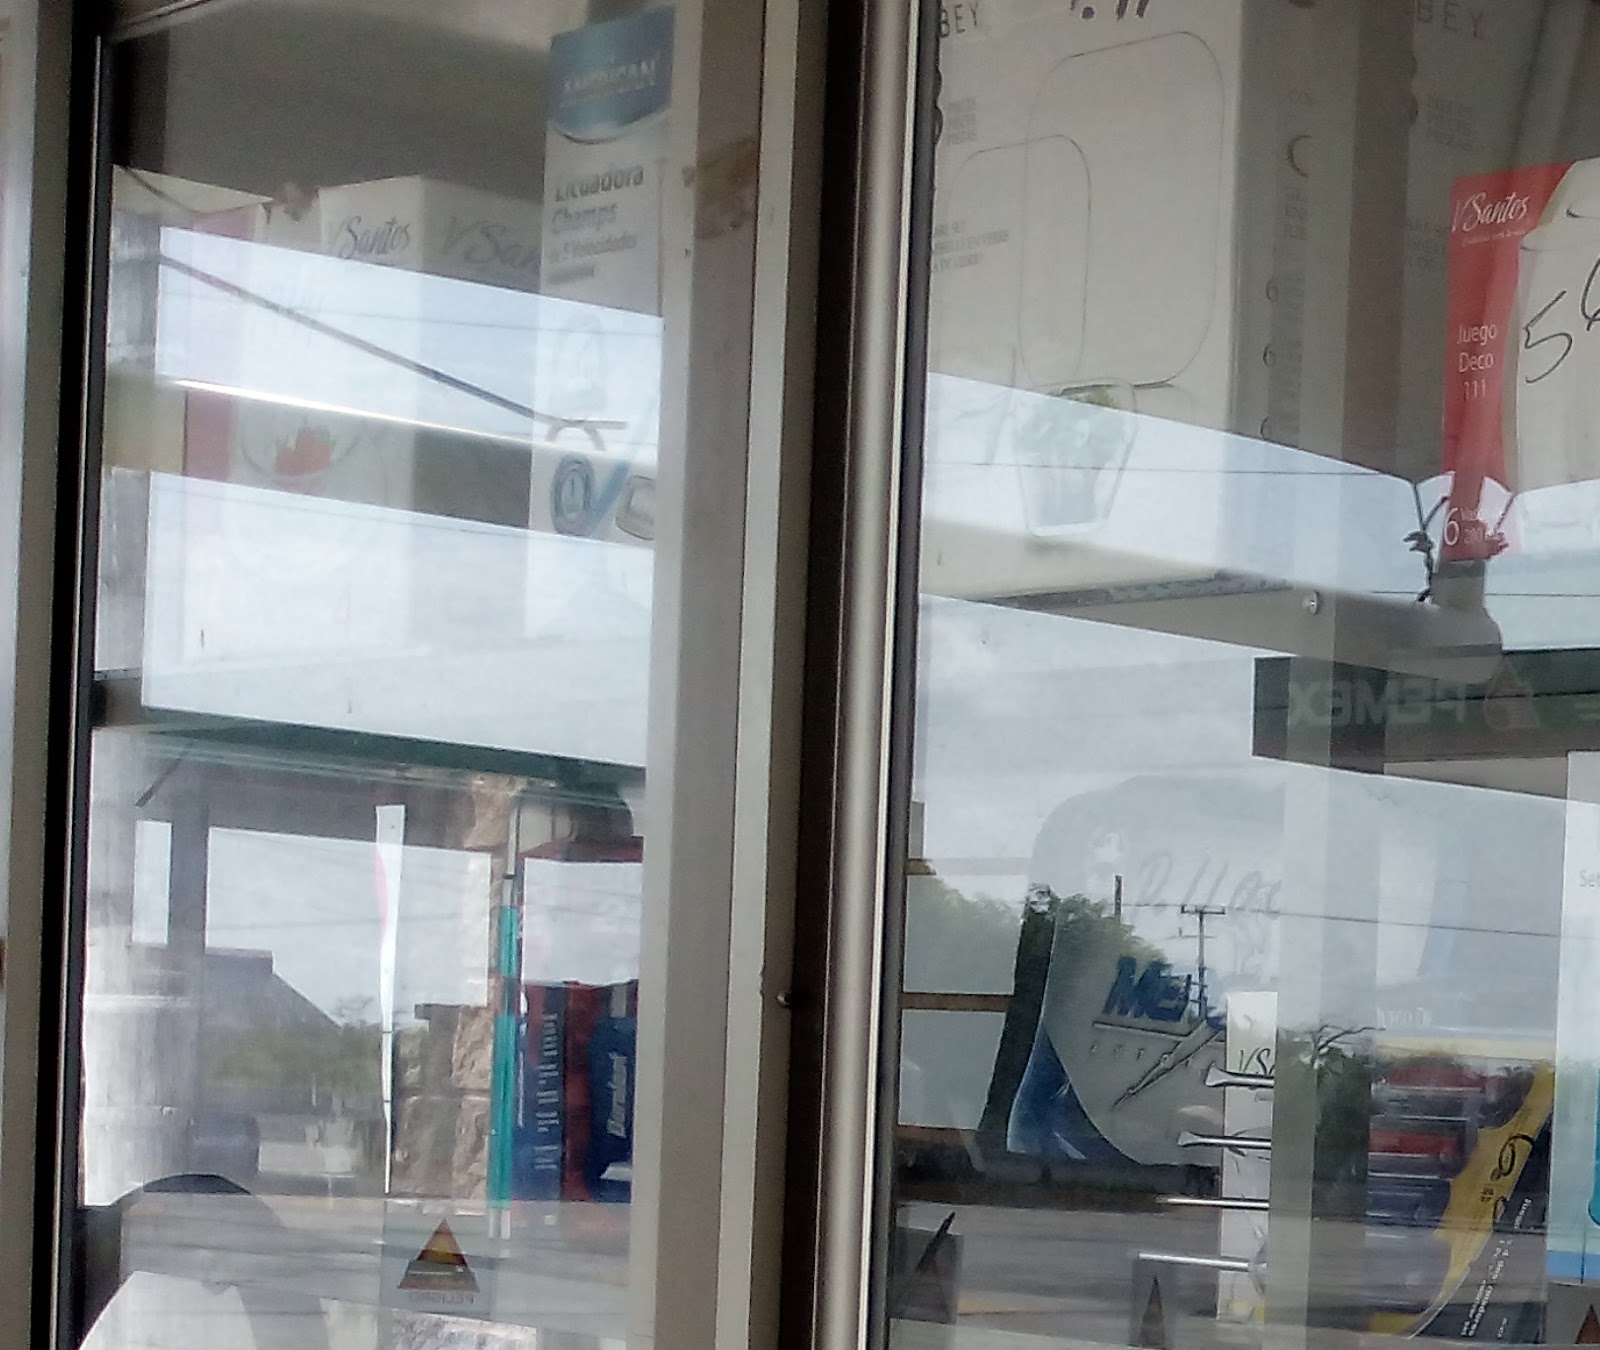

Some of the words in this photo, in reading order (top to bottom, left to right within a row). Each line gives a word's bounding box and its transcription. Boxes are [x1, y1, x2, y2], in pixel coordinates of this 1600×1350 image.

[1457, 323, 1497, 346] Juego
[1458, 352, 1494, 372] Deco
[1444, 507, 1459, 546] 6
[1579, 870, 1600, 888] Set
